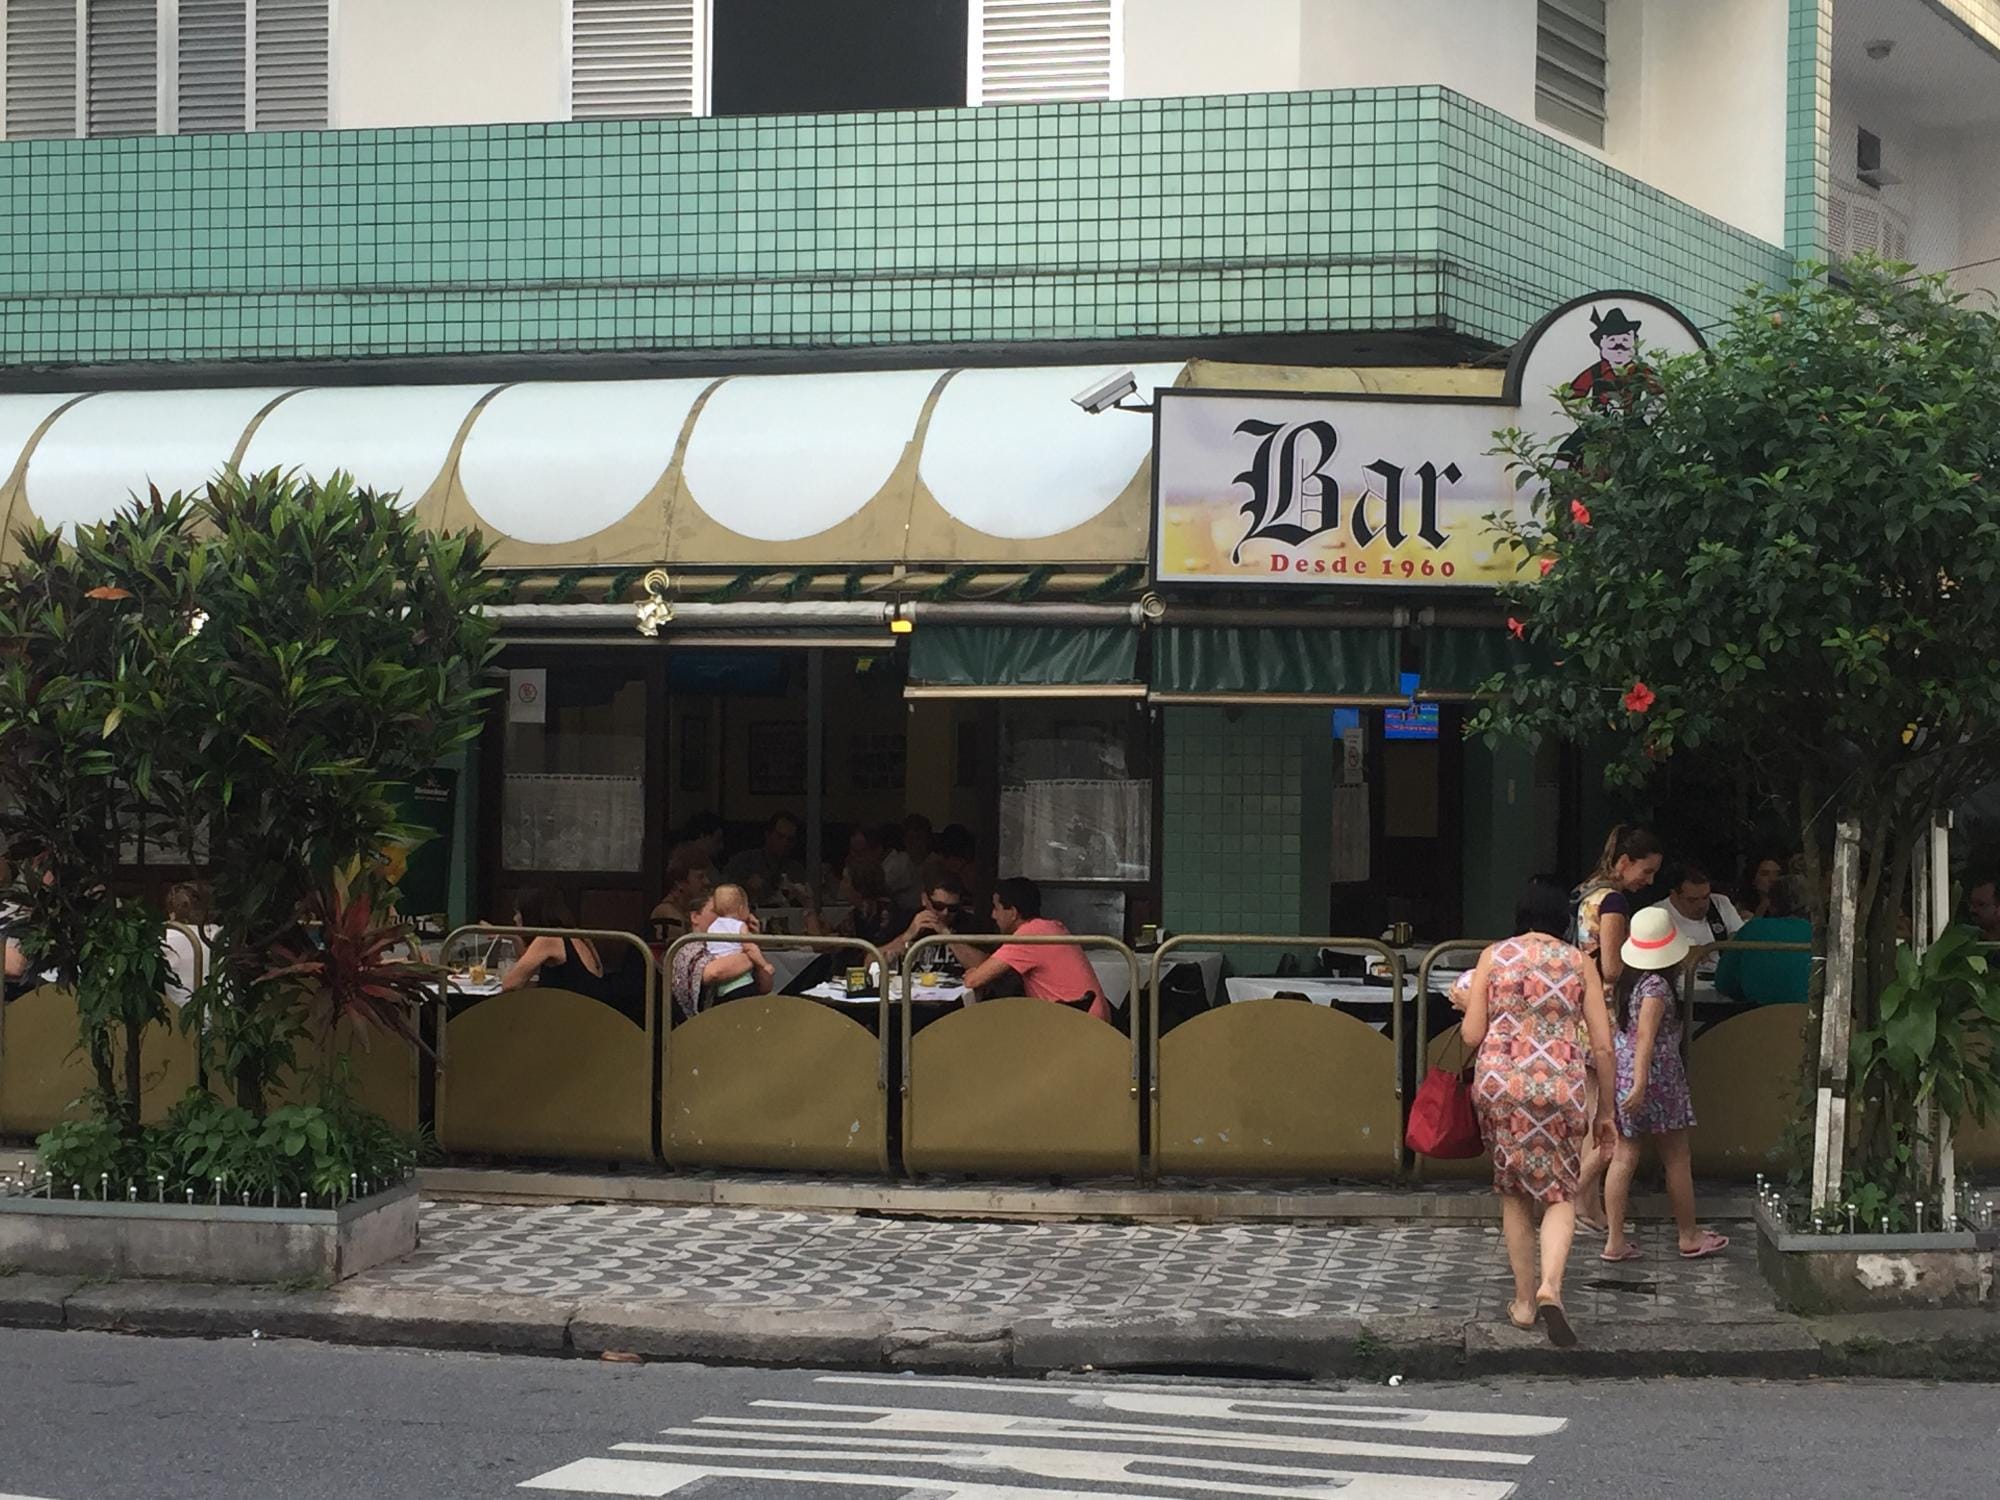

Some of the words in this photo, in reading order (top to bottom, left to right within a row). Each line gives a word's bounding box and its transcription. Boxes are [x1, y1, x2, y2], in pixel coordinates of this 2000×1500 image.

[1231, 419, 1462, 564] Bar
[1270, 554, 1367, 574] Desde
[1382, 559, 1455, 578] 1960
